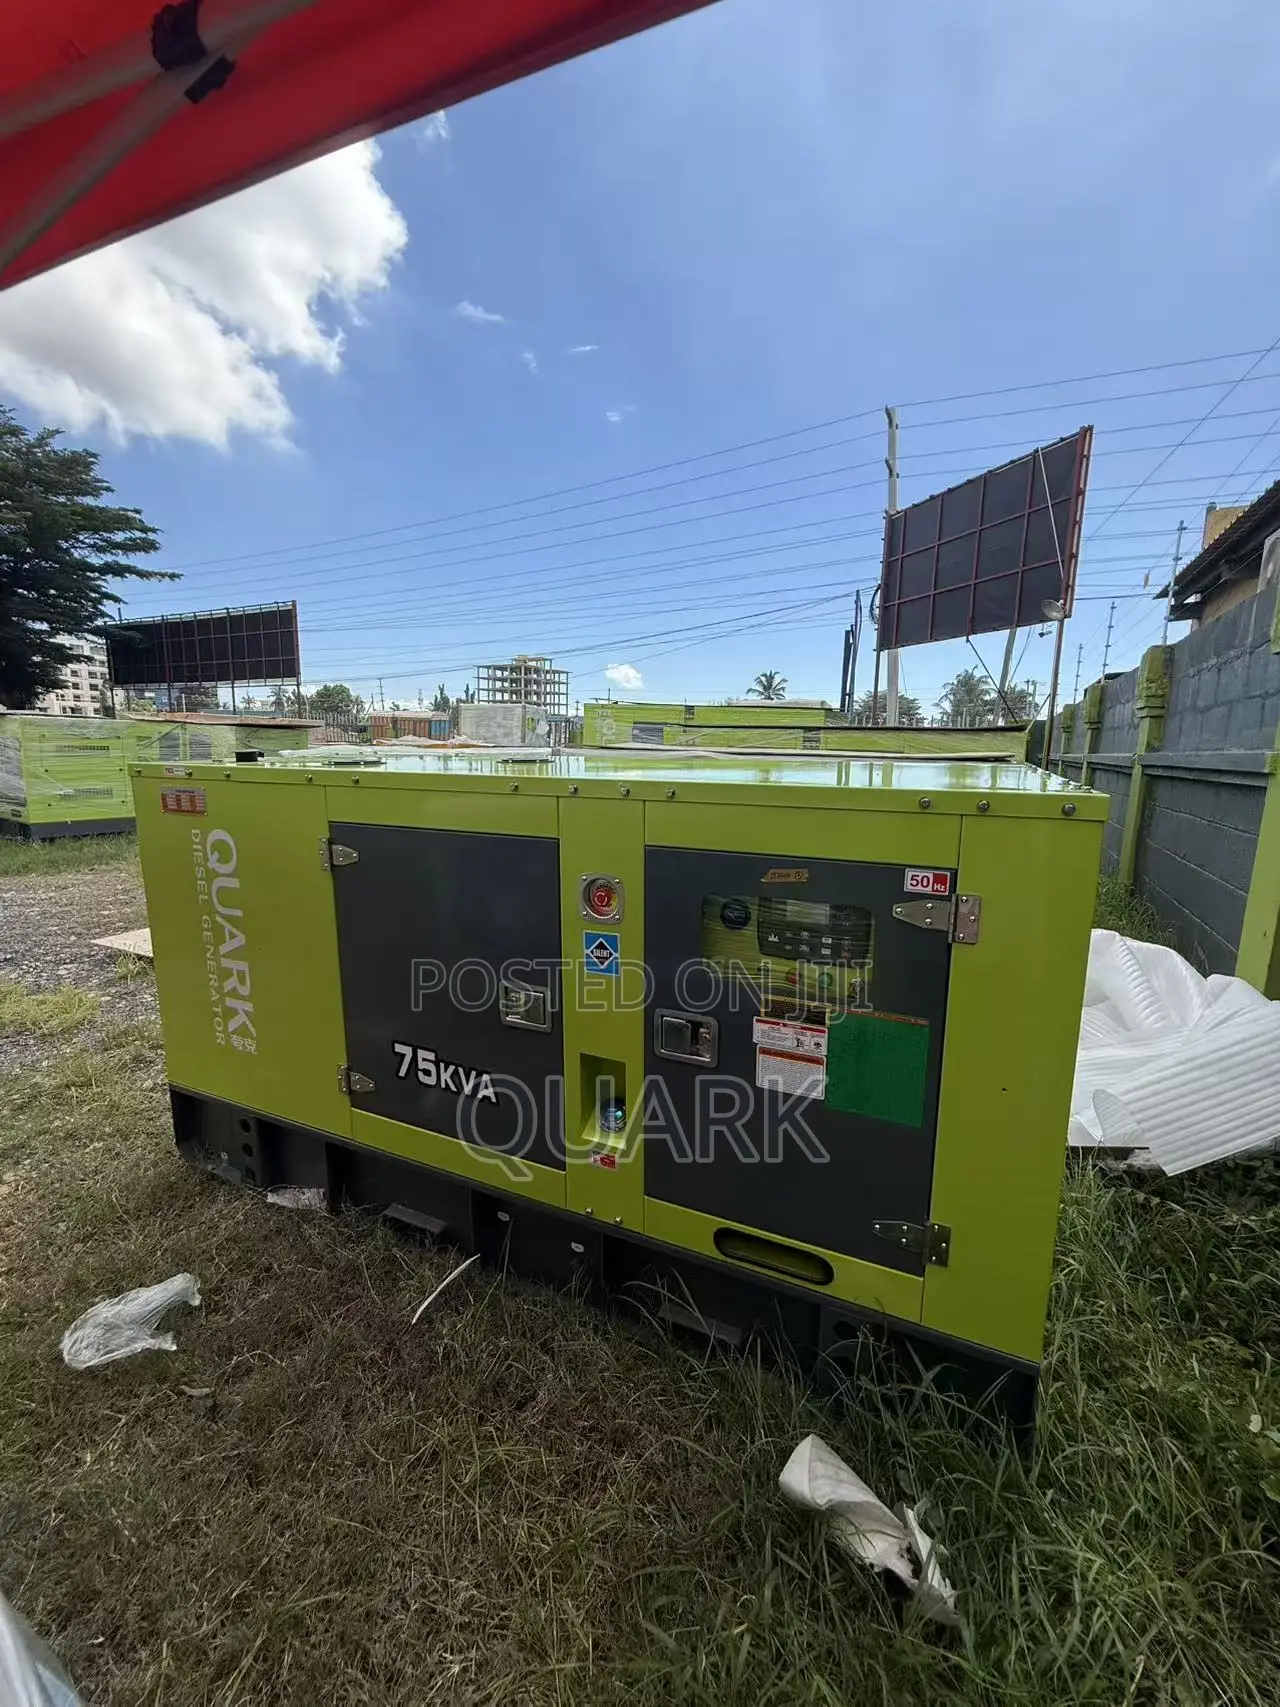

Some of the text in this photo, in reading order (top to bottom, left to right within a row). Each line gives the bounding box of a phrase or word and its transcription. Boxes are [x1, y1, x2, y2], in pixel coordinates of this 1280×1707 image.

[910, 874, 946, 892] 50 Hz
[192, 829, 226, 1046] DIESEL GENERATOR
[206, 829, 257, 1037] QUARK
[592, 948, 610, 958] SILENT
[393, 1042, 498, 1103] 75KVA
